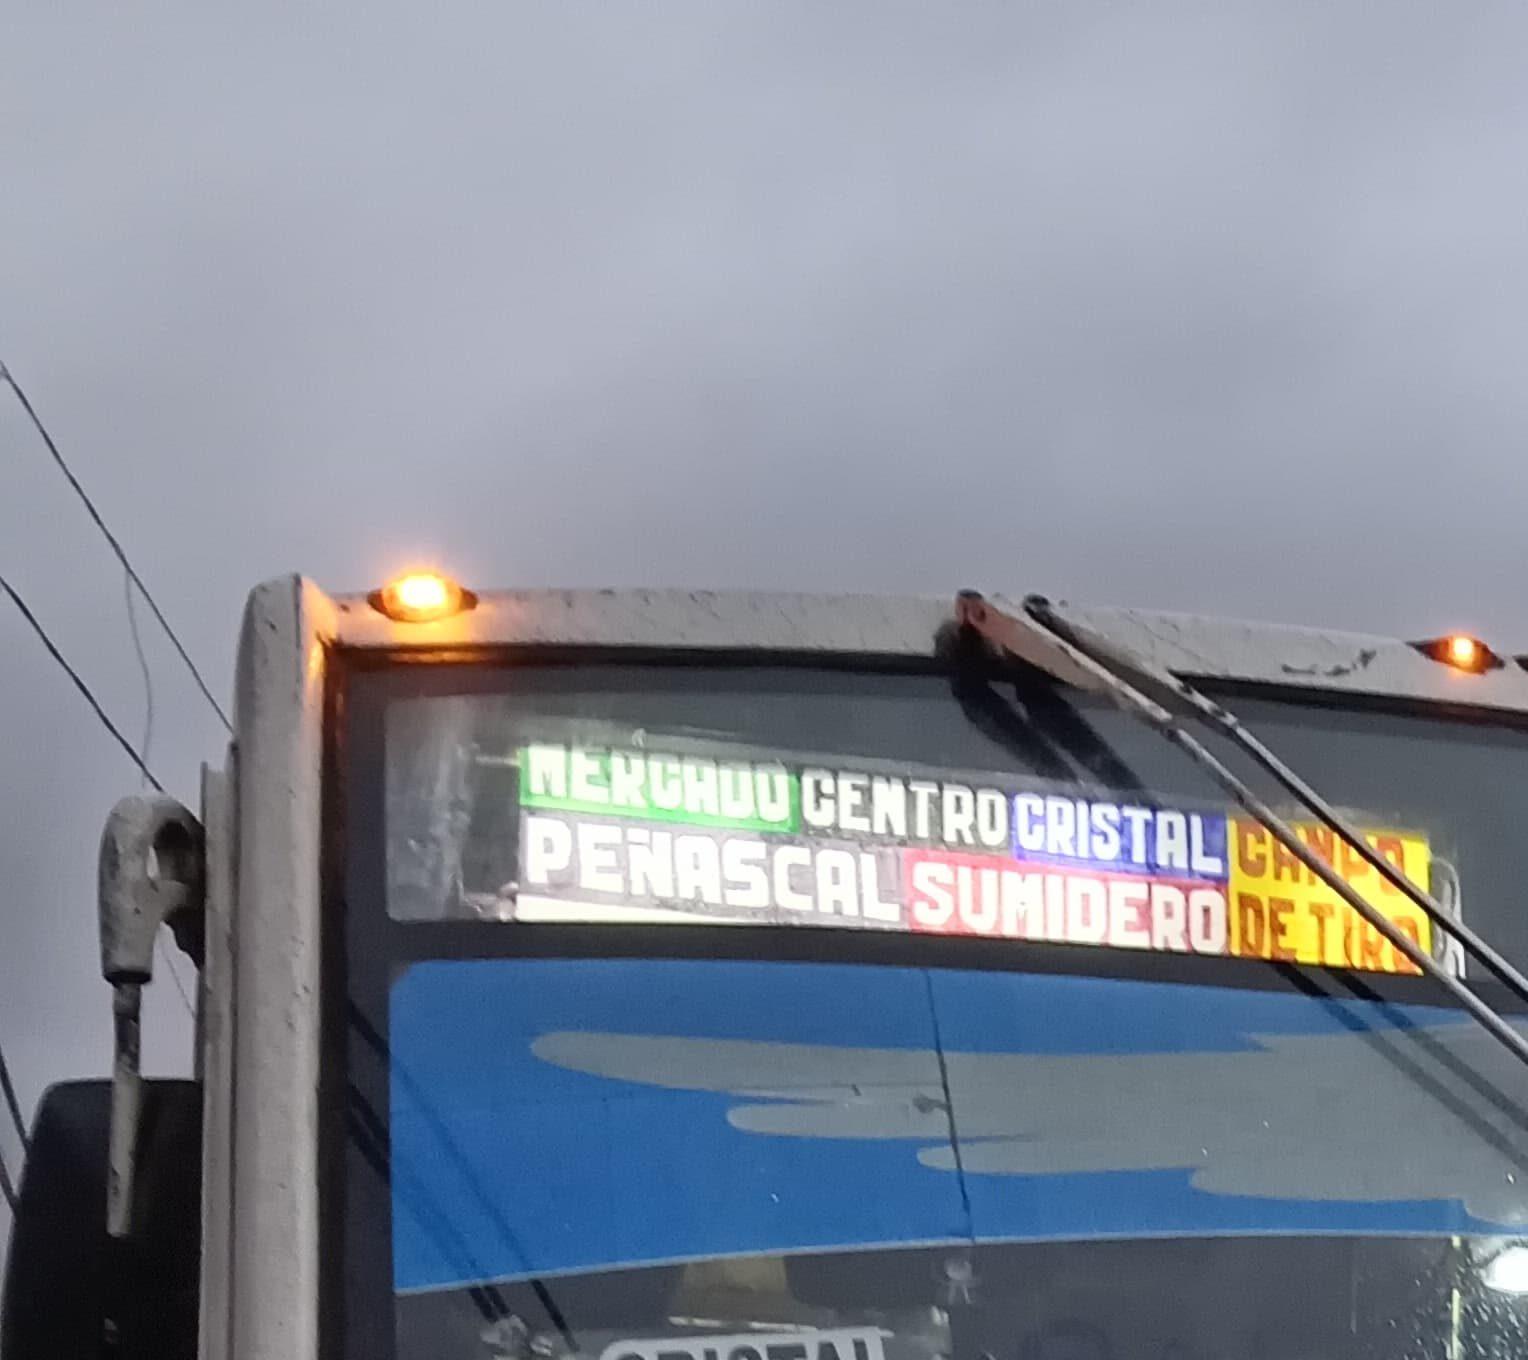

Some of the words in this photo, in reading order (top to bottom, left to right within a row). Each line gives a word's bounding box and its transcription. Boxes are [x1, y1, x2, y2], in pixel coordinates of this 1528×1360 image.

[526, 743, 792, 824] MERCADO
[801, 768, 1008, 850] CENTRO
[1013, 791, 1223, 874] CRISTAL
[524, 816, 902, 922] PEÑASCAL
[910, 860, 1227, 954] SUMIDERO
[1236, 890, 1298, 961] DE
